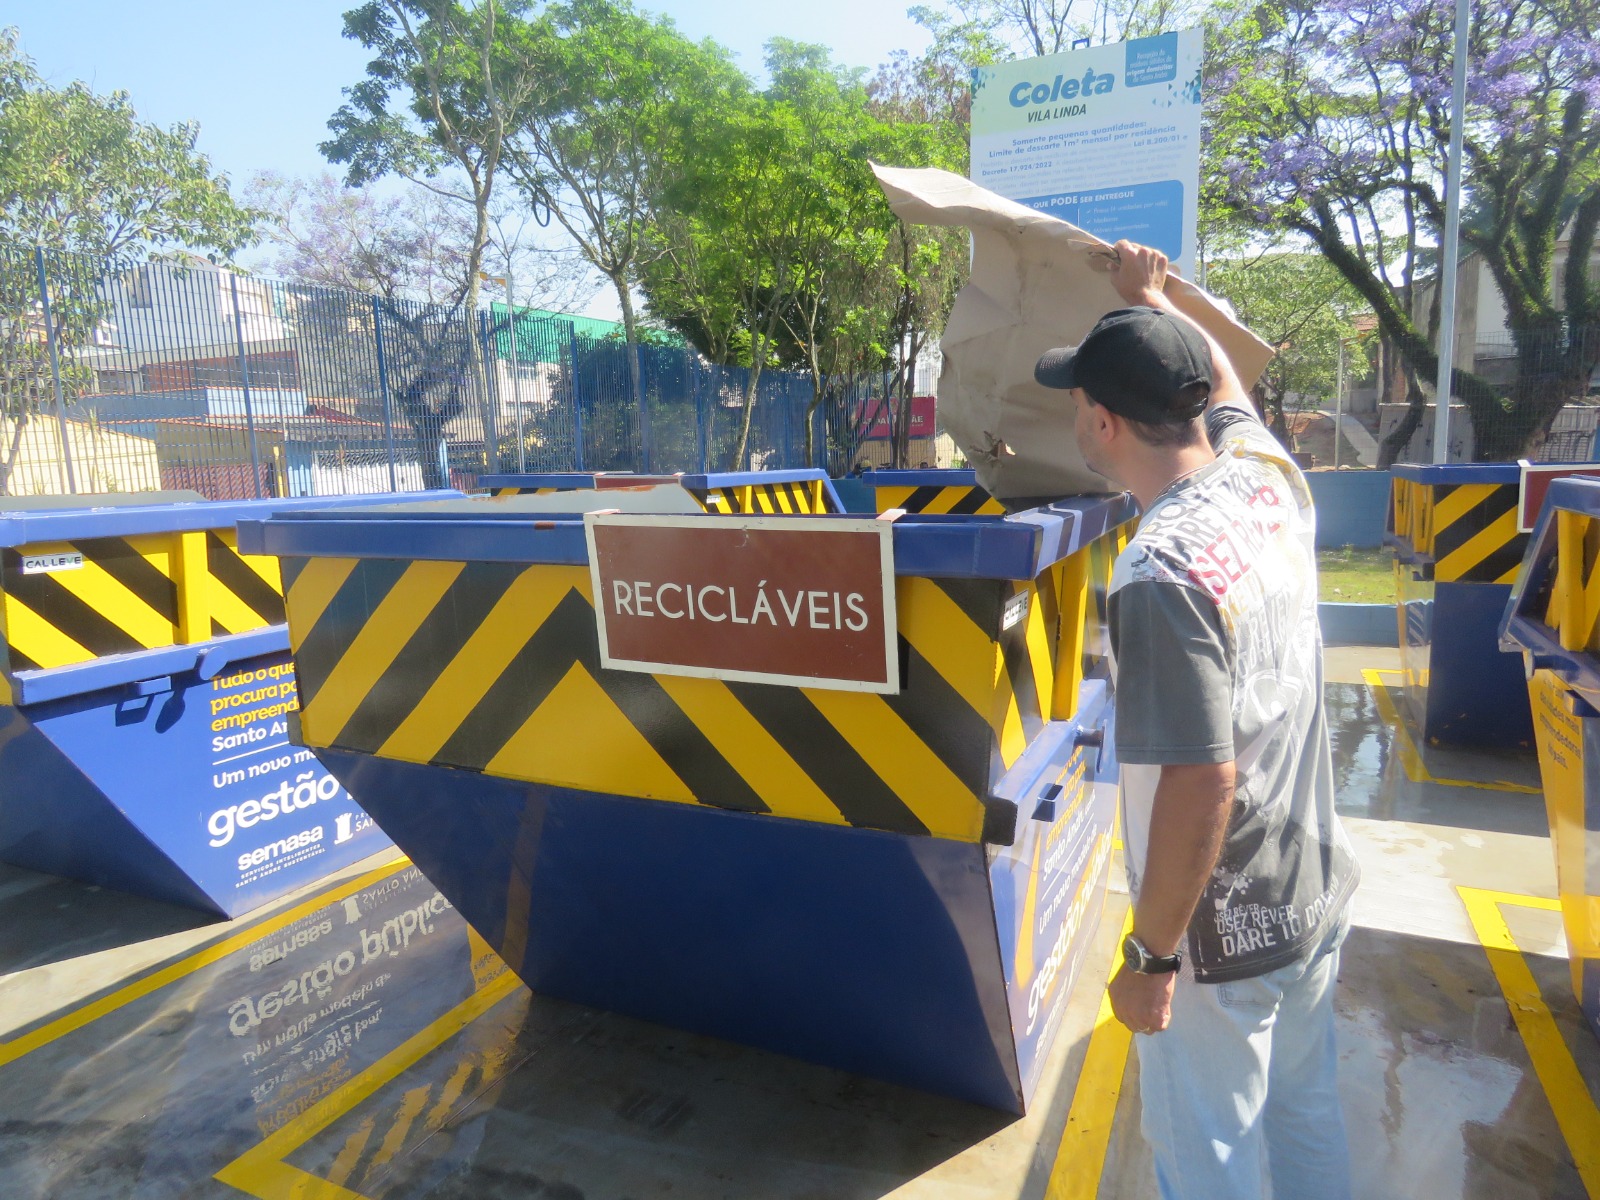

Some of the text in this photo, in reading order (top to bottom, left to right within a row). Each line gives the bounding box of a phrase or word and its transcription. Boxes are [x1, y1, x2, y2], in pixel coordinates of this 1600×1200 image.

[1009, 69, 1115, 108] Coleta
[1028, 104, 1086, 122] VILA LINDA
[989, 149, 1012, 158] Limite
[1027, 142, 1060, 152] descarte
[1081, 134, 1112, 144] mensal
[1114, 132, 1128, 142] por
[1131, 126, 1176, 137] residência
[1012, 121, 1147, 147] Somente pequenas quantidades:
[1133, 139, 1145, 147] Lei
[982, 168, 1007, 176] Decreto
[1033, 201, 1048, 209] QUE
[1050, 195, 1078, 207] PODE
[1095, 190, 1135, 202] ENTREGUE
[612, 580, 868, 632] RECICLÁVEIS
[210, 662, 295, 690] Tudo o que
[210, 685, 277, 715] procura
[212, 727, 267, 752] Santo
[213, 769, 245, 789] Um
[248, 755, 291, 778] novo
[208, 771, 340, 848] gestão
[238, 825, 323, 871] semasa
[1043, 838, 1066, 882] Santo
[235, 876, 257, 888] SANTO
[1039, 904, 1053, 935] Um
[1053, 874, 1071, 916] novo
[1221, 927, 1277, 956] DARE
[1026, 901, 1080, 1036] gestão
